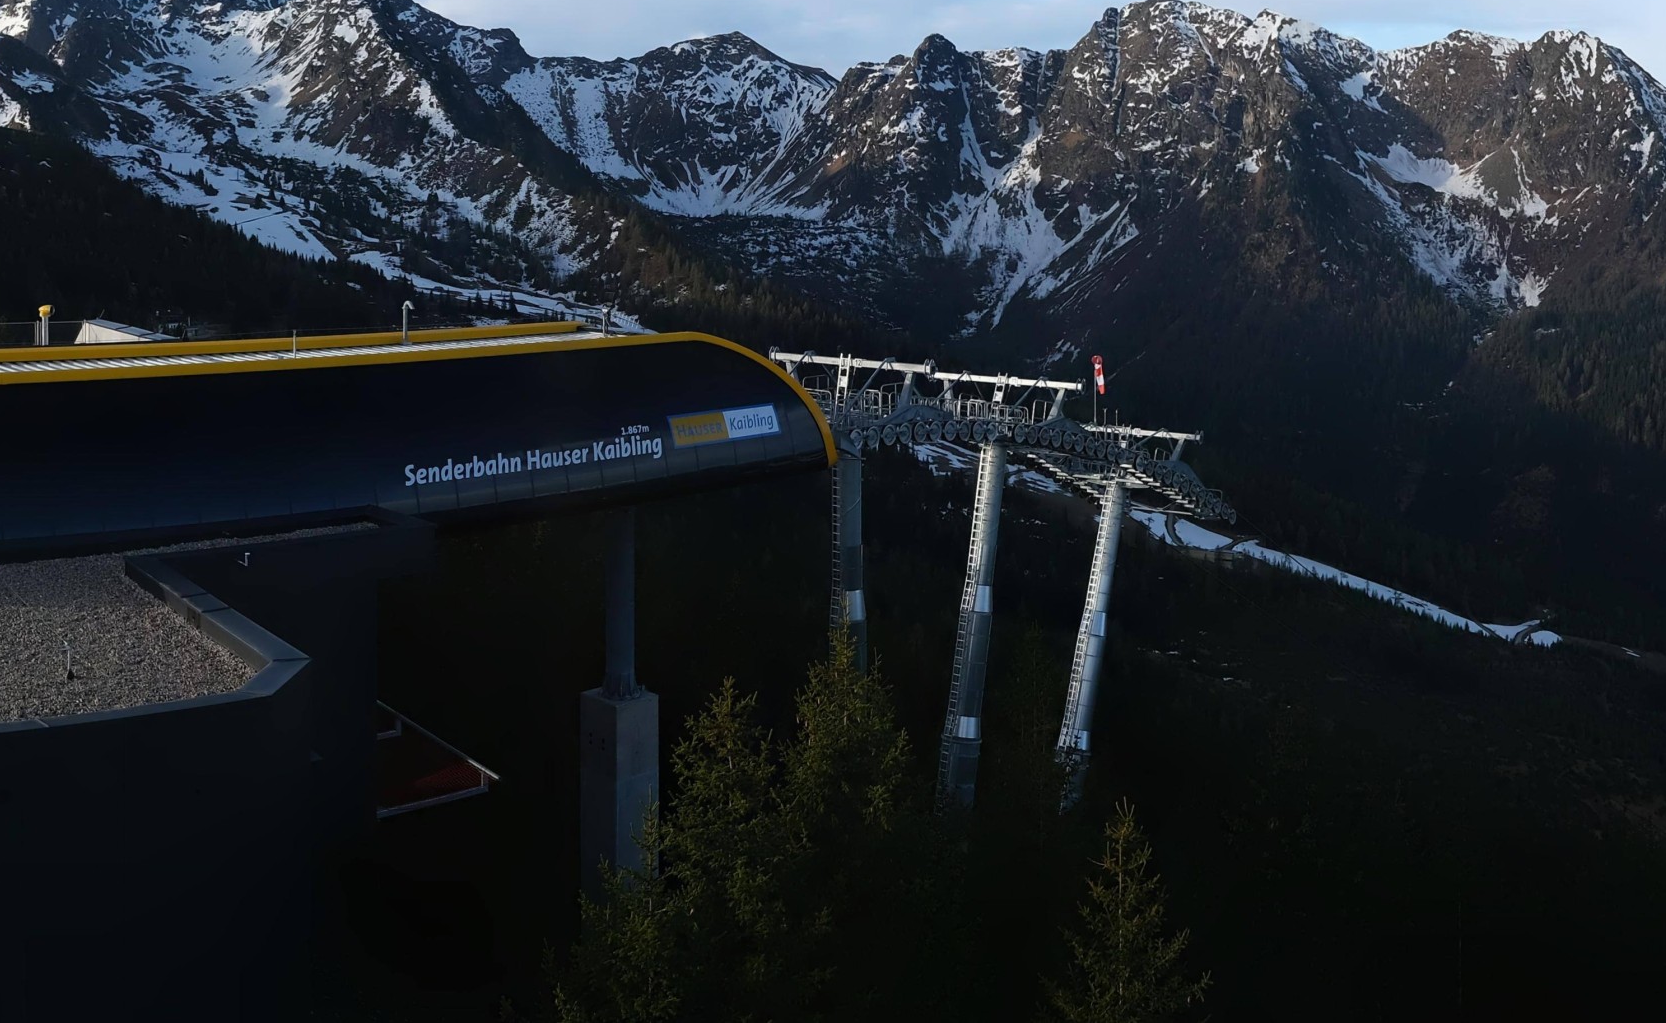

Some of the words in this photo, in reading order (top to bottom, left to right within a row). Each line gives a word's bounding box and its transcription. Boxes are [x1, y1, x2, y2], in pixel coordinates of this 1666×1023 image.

[620, 424, 650, 436] 1.867m
[676, 421, 723, 438] HAUSER
[729, 414, 774, 433] Kaibling
[404, 452, 522, 487] Senderbahn
[526, 447, 589, 471] Hauser
[592, 435, 662, 461] Kaibling
